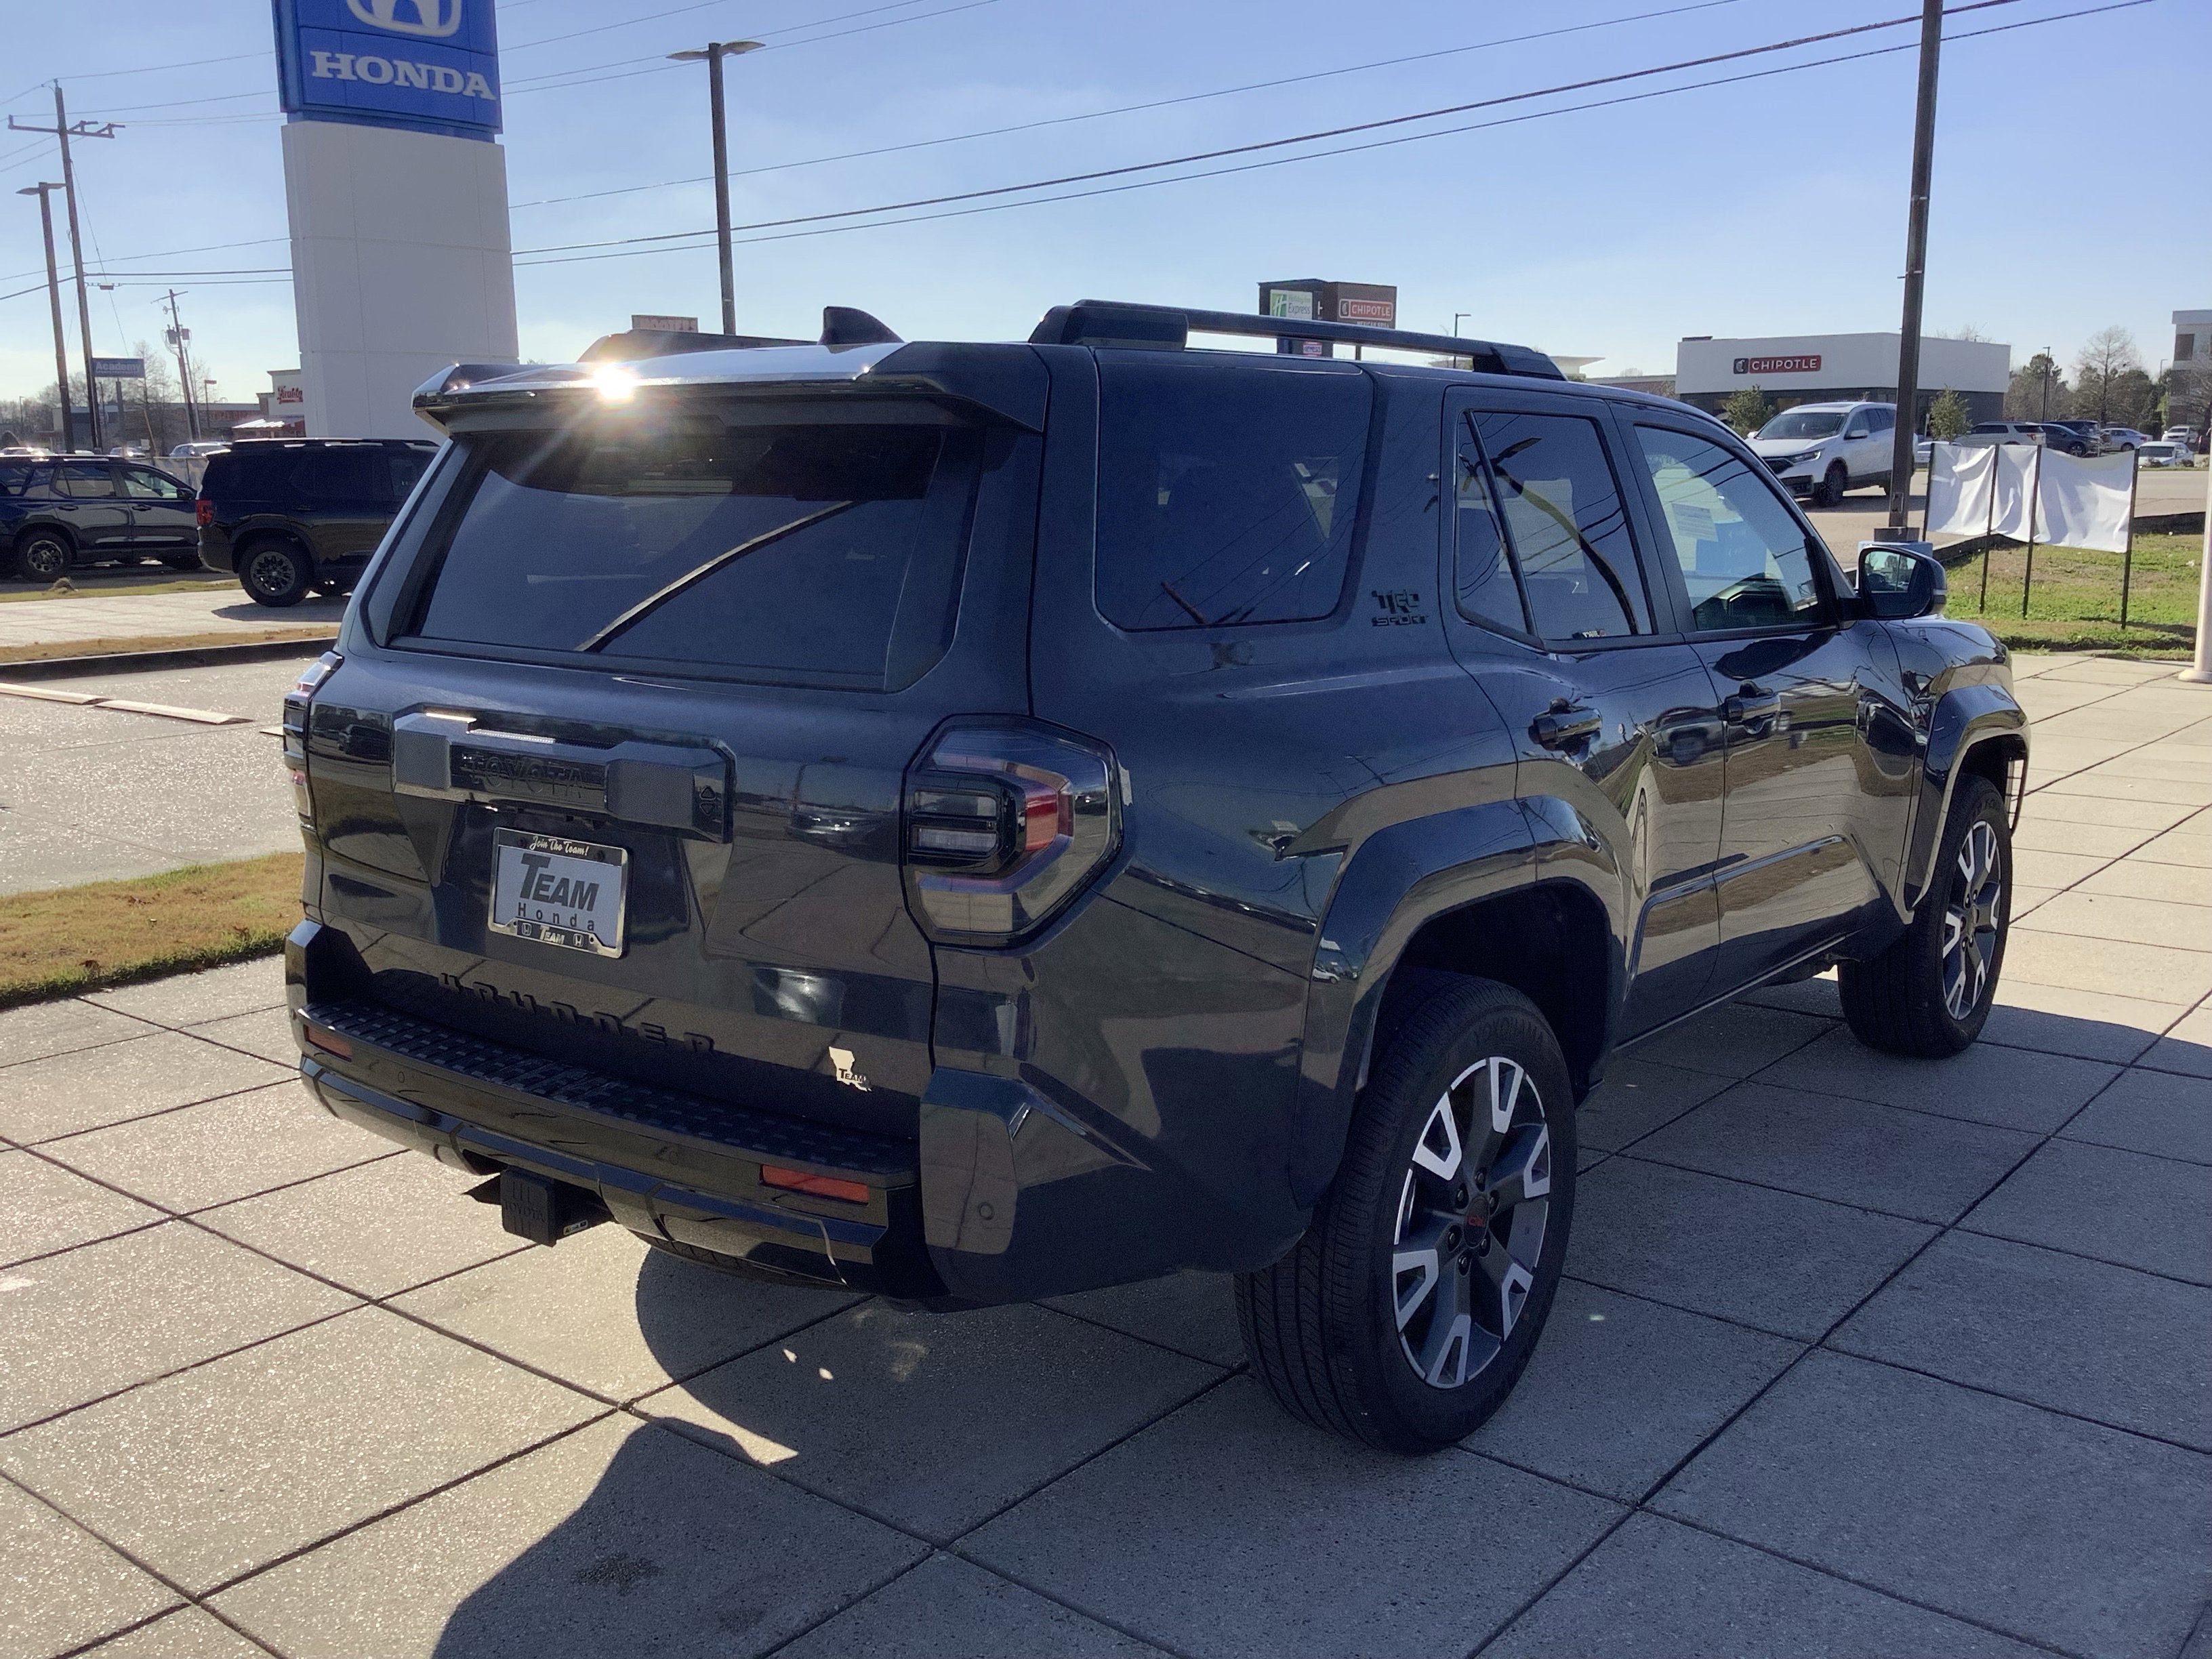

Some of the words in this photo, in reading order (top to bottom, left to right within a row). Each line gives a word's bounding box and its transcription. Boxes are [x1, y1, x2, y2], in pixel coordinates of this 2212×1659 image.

[310, 51, 497, 100] HONDA
[1288, 302, 1311, 315] Express
[1352, 304, 1391, 316] CHIPOTLE
[96, 361, 141, 373] Academy
[1752, 359, 1817, 370] CHIPOTLE
[1372, 589, 1420, 614] TRD
[1372, 615, 1429, 627] SPORT
[469, 751, 583, 800] TOYOTA
[529, 836, 548, 851] Join
[548, 838, 562, 851] The
[563, 841, 590, 856] Team!
[520, 853, 599, 912] TEAM
[518, 902, 594, 931] Honda
[539, 924, 565, 945] TEAM
[838, 1067, 865, 1082] TEAM
[505, 1201, 546, 1223] TOYOTA
